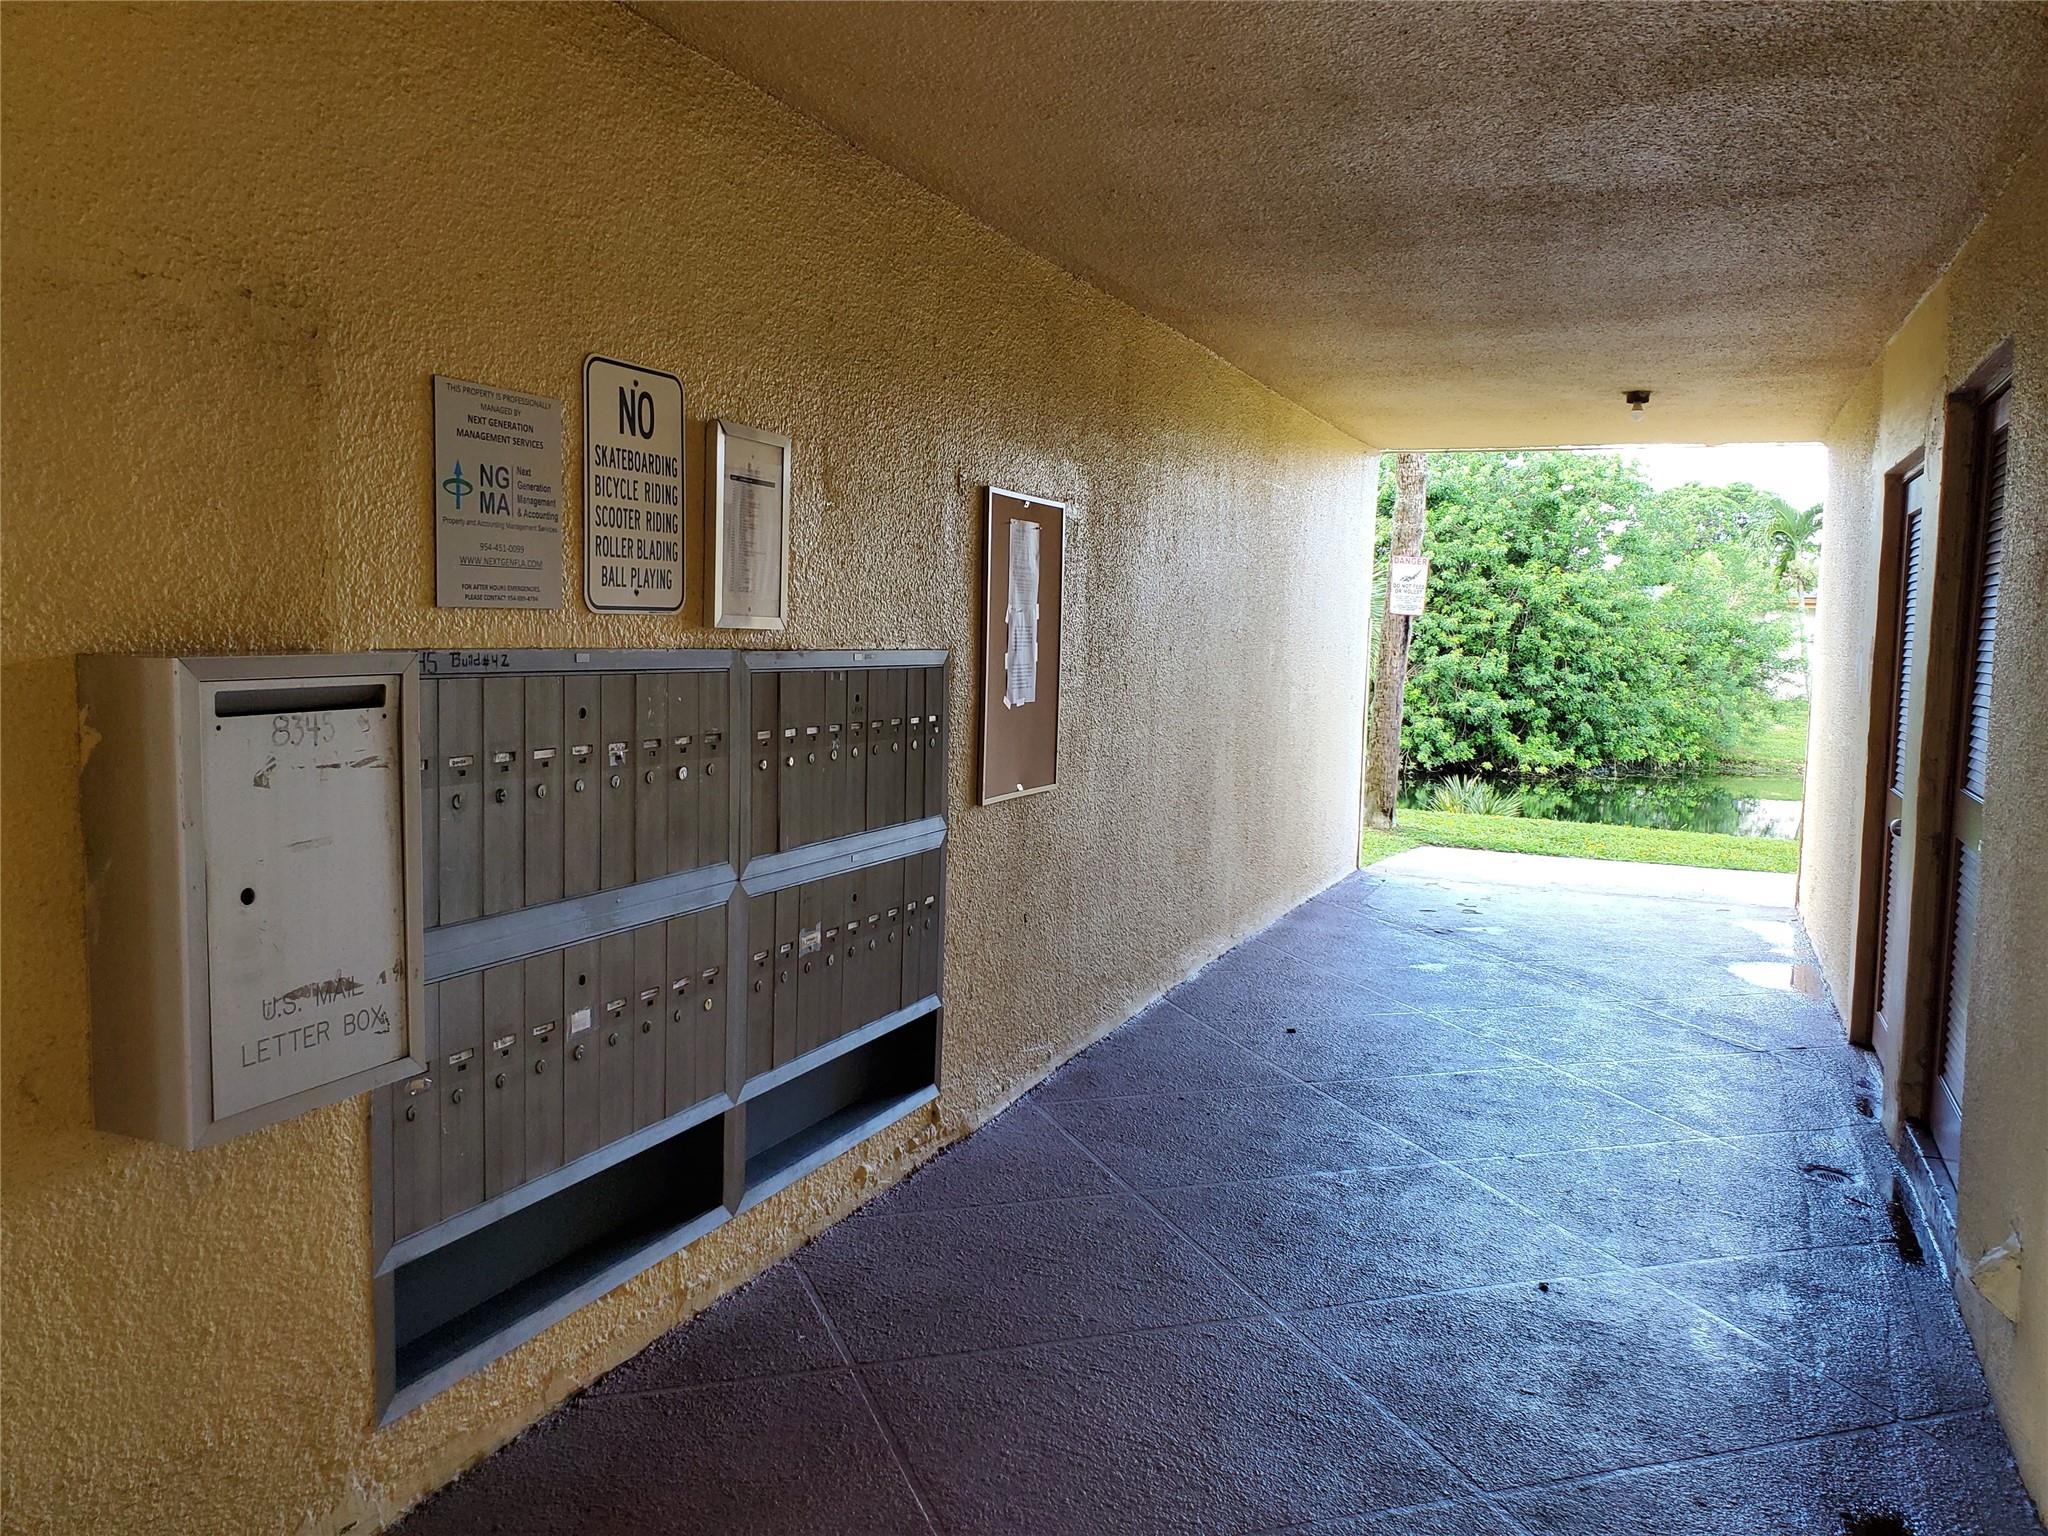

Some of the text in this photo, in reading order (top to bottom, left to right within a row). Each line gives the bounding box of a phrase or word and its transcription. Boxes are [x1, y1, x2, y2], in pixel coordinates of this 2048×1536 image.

[446, 382, 461, 393] THIS
[462, 386, 494, 399] PROPERTY
[502, 393, 552, 410] PROFESSIONALLY
[480, 403, 521, 417] MANAGED BY
[619, 386, 655, 440] NO
[467, 414, 534, 433] NEXT GENERATION
[456, 428, 544, 450] MANAGEMENT SERVICES
[516, 466, 532, 477] Next
[594, 444, 678, 478] SKATEBOARDING
[480, 463, 510, 489] NG
[517, 480, 552, 493] Generation
[517, 494, 556, 508] Management
[595, 474, 678, 506] BICYCLE RIDING
[480, 491, 511, 516] MA
[517, 508, 559, 523] & Accounting
[442, 516, 465, 527] Property
[476, 520, 505, 530] Accounting
[505, 522, 537, 532] Management
[538, 525, 558, 534] Services
[595, 504, 678, 534] SCOOTER RIDING
[479, 542, 525, 554] 954-451-0099
[595, 535, 678, 562] ROLLER BLADING
[1394, 557, 1427, 565] DANGER
[601, 565, 673, 590] BALL PLAYING
[464, 593, 484, 601] PLEASE
[484, 594, 507, 602] CONTACT
[272, 712, 335, 747] 8345
[262, 976, 364, 1022] U.S. MAIL
[242, 1004, 384, 1067] LETTER BOX
